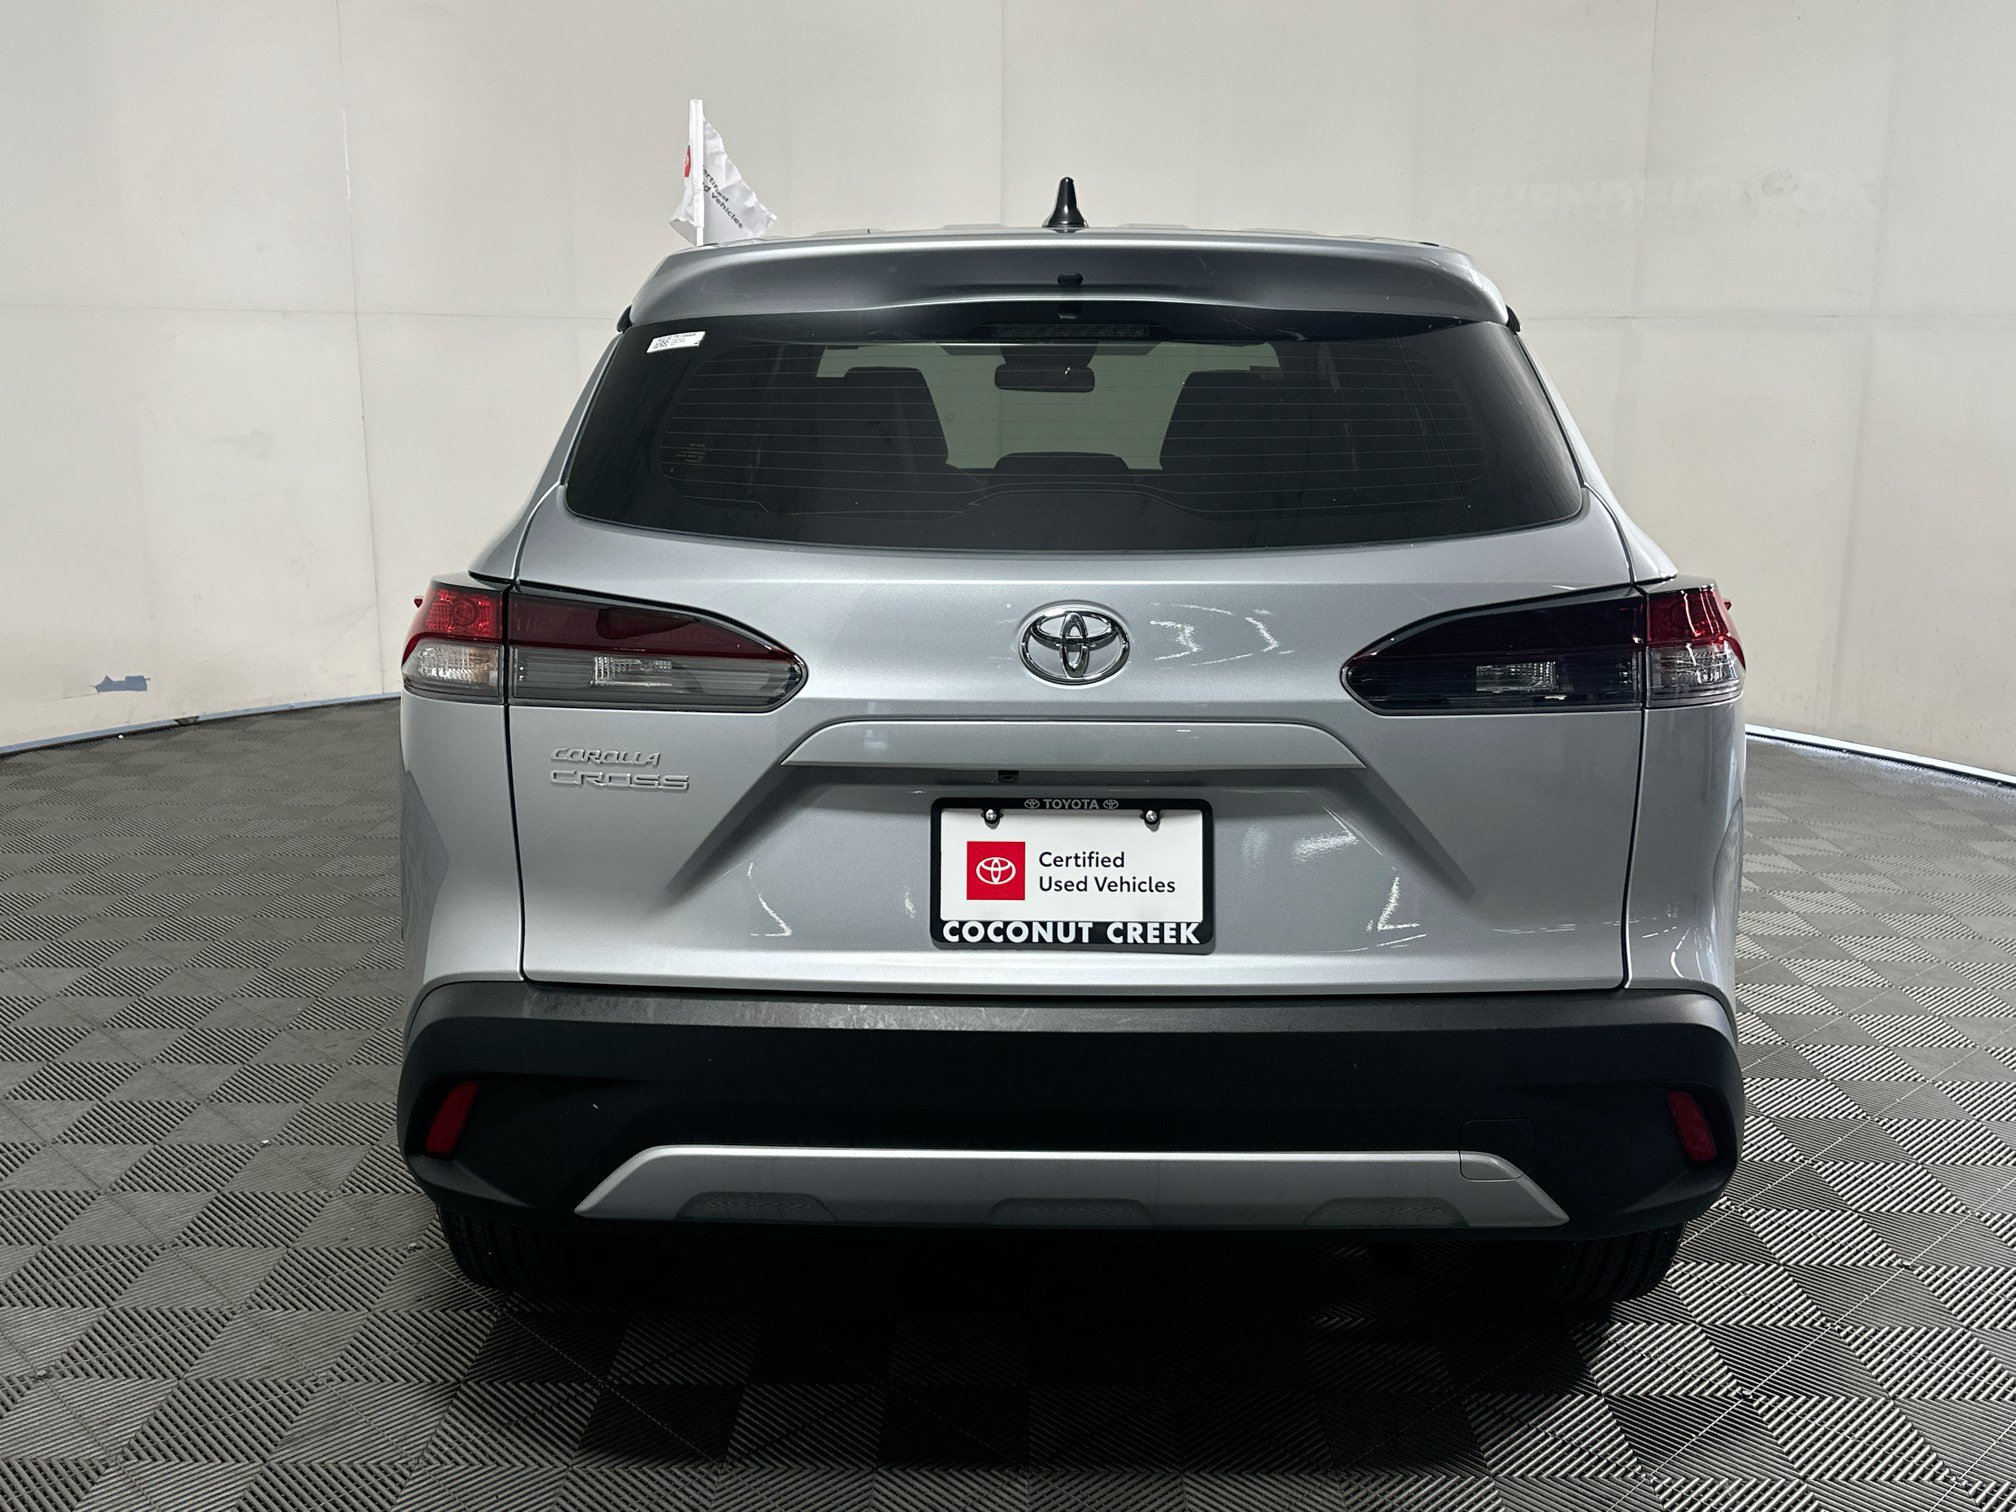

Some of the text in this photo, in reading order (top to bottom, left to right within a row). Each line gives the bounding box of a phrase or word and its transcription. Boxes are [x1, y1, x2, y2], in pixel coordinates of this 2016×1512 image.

[702, 165, 729, 202] ertified
[550, 748, 661, 766] COROLLA
[550, 770, 689, 791] CROSS
[1043, 798, 1100, 810] TOYOTA
[1038, 851, 1125, 868] Certified
[1038, 876, 1176, 893] Used Vehicles
[942, 920, 1201, 944] COCONUT CREEK
